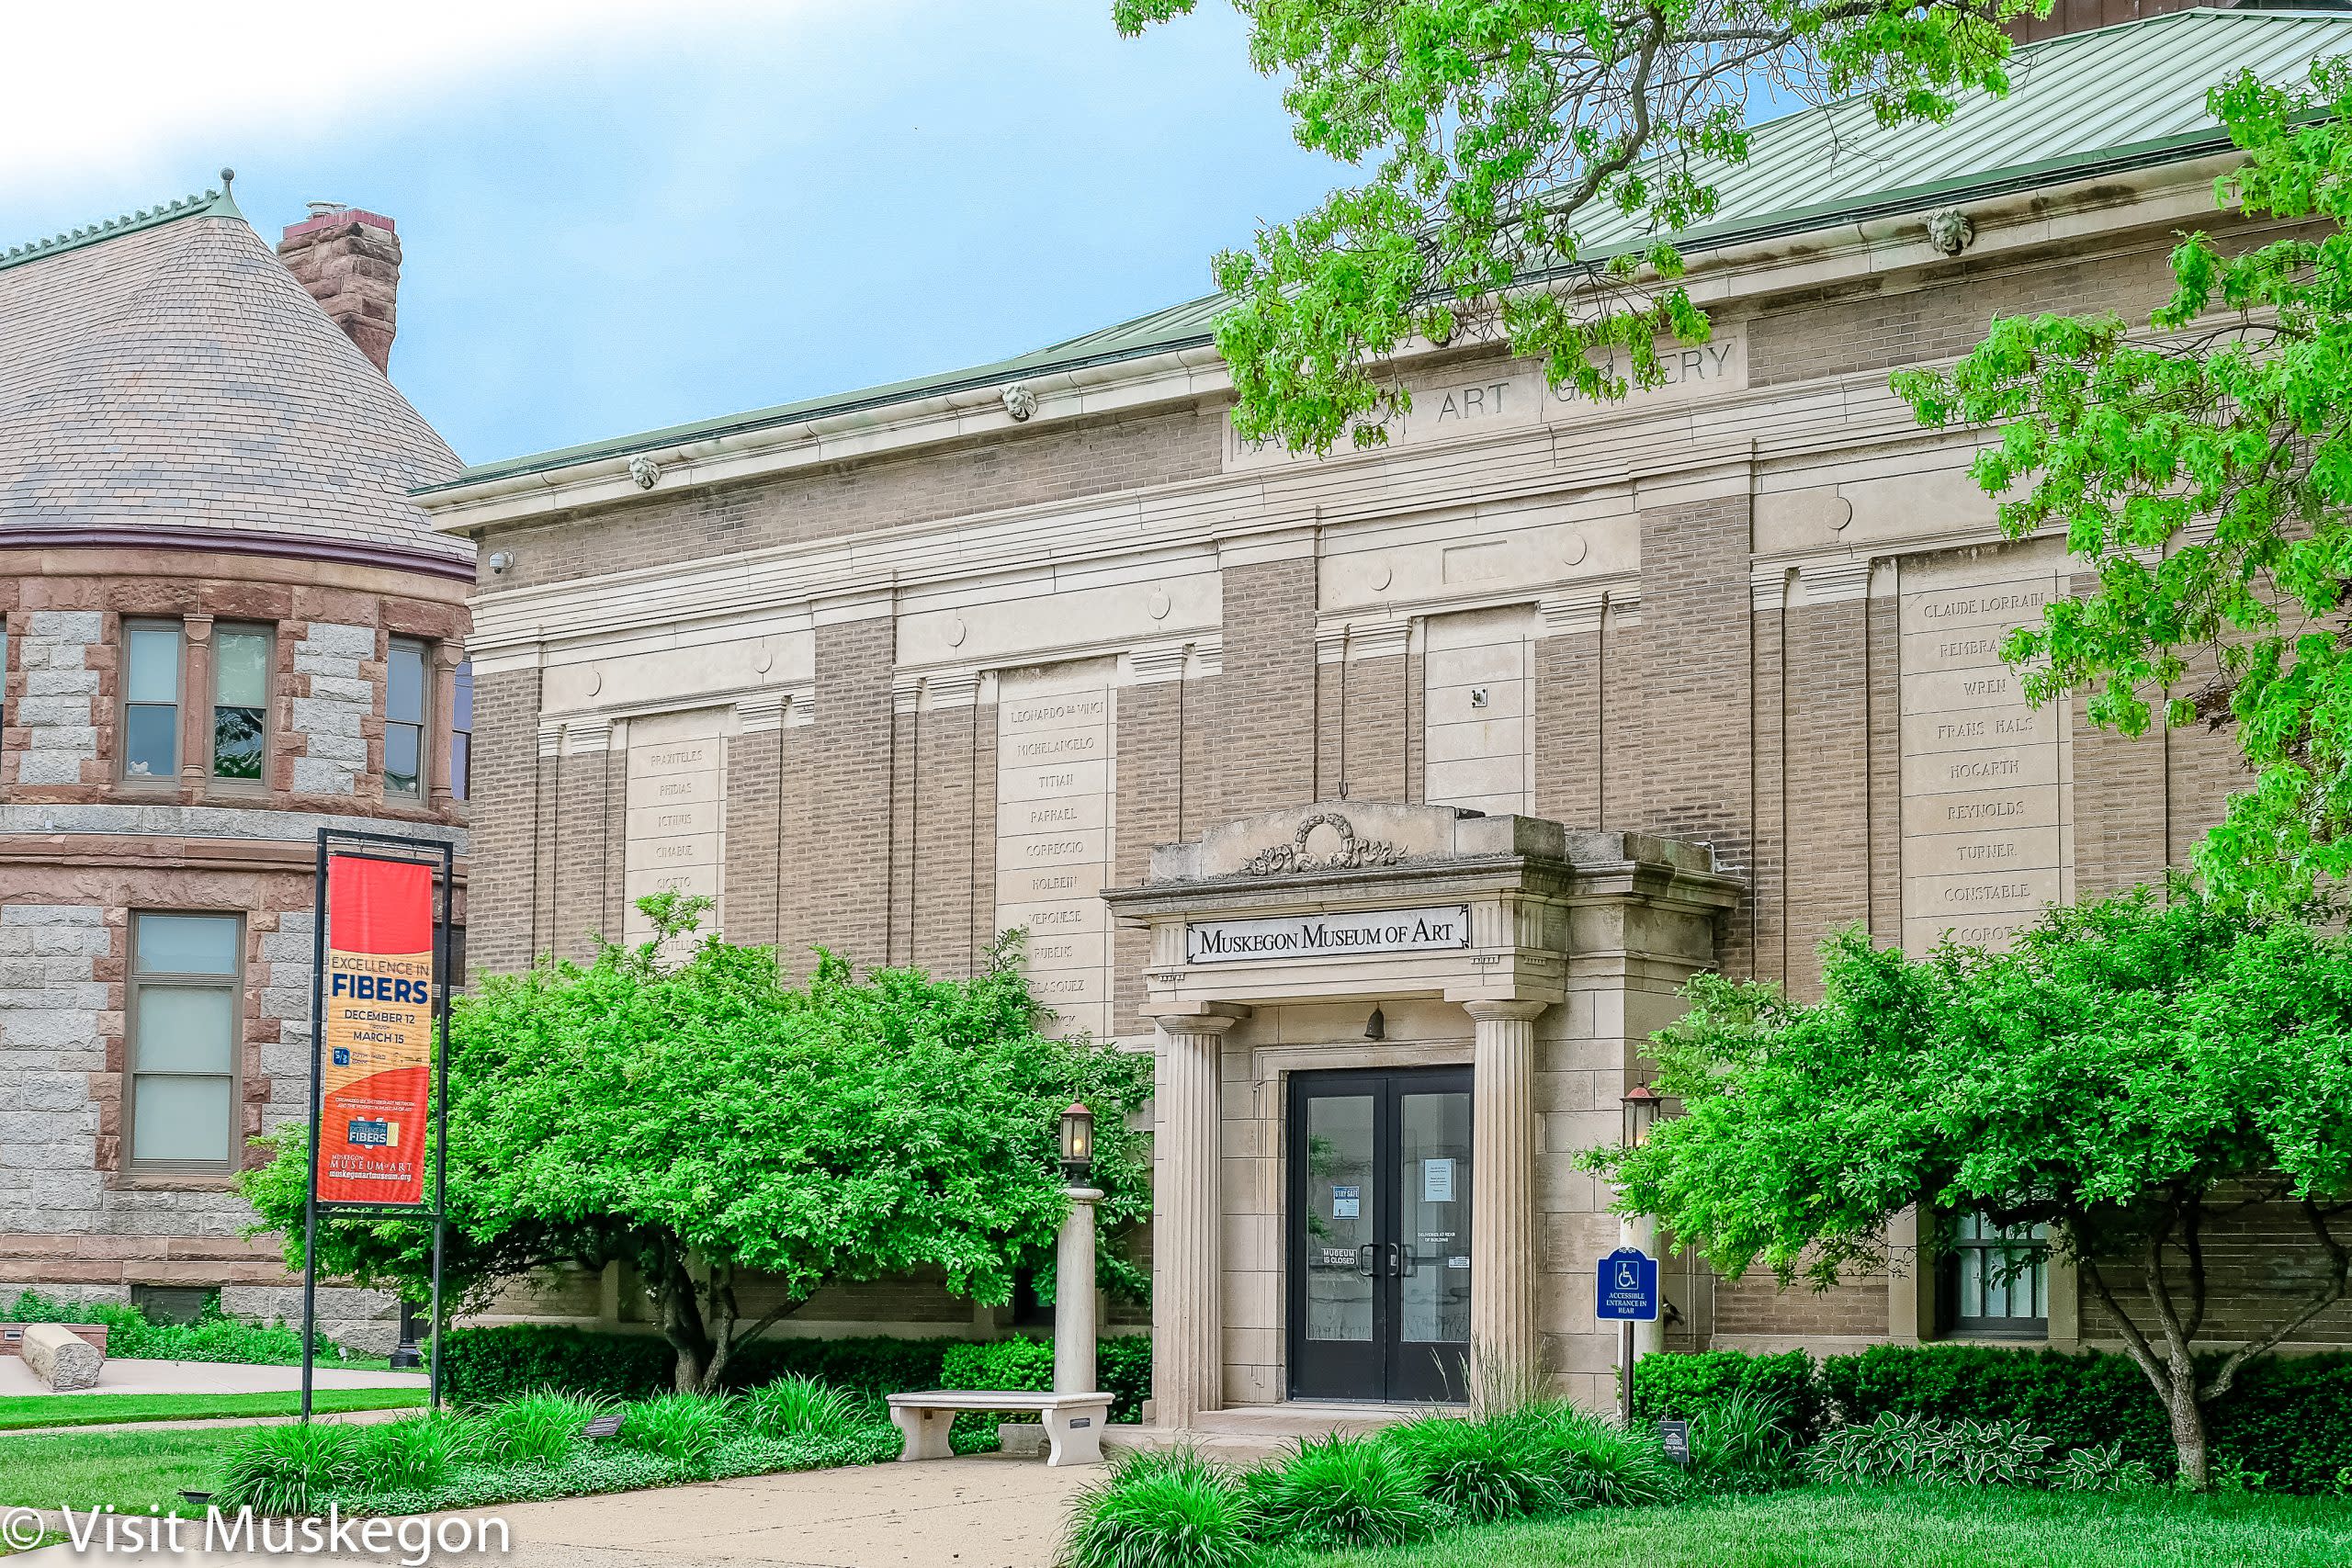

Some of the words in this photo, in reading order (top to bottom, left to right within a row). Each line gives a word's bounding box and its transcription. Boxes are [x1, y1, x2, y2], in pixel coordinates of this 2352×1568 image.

[1438, 381, 1510, 423] ART
[1924, 599, 1977, 618] CLAUDE
[1981, 592, 2044, 614] LORRAIN
[1963, 679, 2007, 695] WREN
[1011, 706, 1064, 723] LEONARDO
[1078, 701, 1103, 715] VINCI
[1938, 721, 1984, 739] FRANS
[1996, 716, 2033, 734] HALS
[1017, 737, 1094, 757] MICHELANGELO
[650, 750, 703, 766] PRAXITELES
[1951, 760, 2019, 779] HOGARTH
[1038, 773, 1073, 788] TITIAN
[660, 782, 692, 796] PHIDIAS
[1031, 807, 1078, 823] RAPHAEL
[1948, 801, 2024, 820] REYNOLDS
[658, 814, 692, 828] ICTINUS
[656, 845, 693, 858] CIMABUE
[1026, 841, 1084, 856] CORREGGIO
[1957, 843, 2018, 861] TURNER
[1033, 875, 1079, 890] HOLBEIN
[1944, 883, 2030, 901] CONSTABLE
[1028, 910, 1082, 925] VERONESE
[1200, 930, 1299, 954] MUSKEGON
[1301, 923, 1381, 948] MUSEUM
[1411, 917, 1453, 942] ART
[1035, 945, 1073, 959] RUBENS
[332, 957, 413, 976] EXCELLENCE
[416, 964, 429, 976] IN
[332, 973, 428, 1004] FIBERS
[345, 1009, 402, 1023] DECEMBER
[405, 1014, 415, 1024] 12
[353, 1031, 392, 1043] MARCH
[395, 1033, 404, 1044] 15
[349, 1132, 387, 1144] FIBERS
[330, 1160, 384, 1171] MUSEUM
[390, 1162, 413, 1172] ART
[1323, 1249, 1355, 1258] MUSEUM
[1330, 1257, 1355, 1265] CLOSED
[1609, 1292, 1645, 1300] ACCESSIBLE
